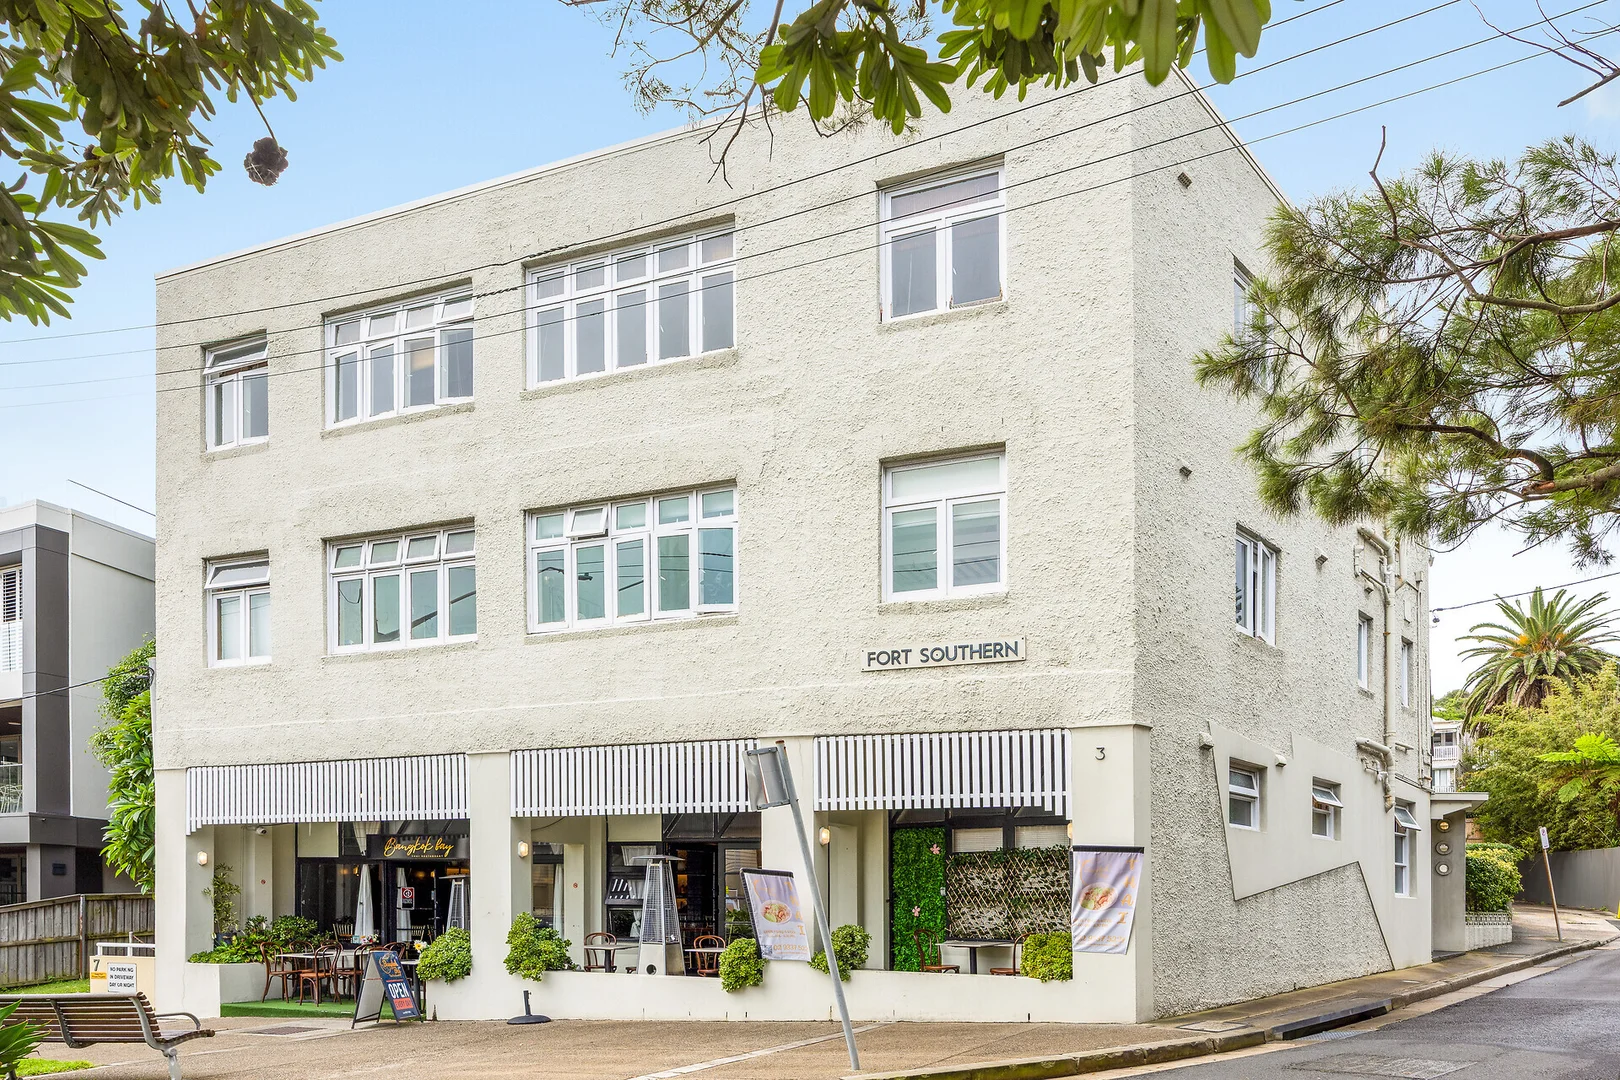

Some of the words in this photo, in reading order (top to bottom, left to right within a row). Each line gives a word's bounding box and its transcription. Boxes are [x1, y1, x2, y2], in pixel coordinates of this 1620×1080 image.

[867, 649, 912, 667] FORT
[920, 641, 1019, 663] SOUTHERN
[1095, 746, 1106, 761] 3
[383, 836, 434, 857] Bangkok
[93, 959, 100, 971] 7
[388, 982, 410, 999] OPEN
